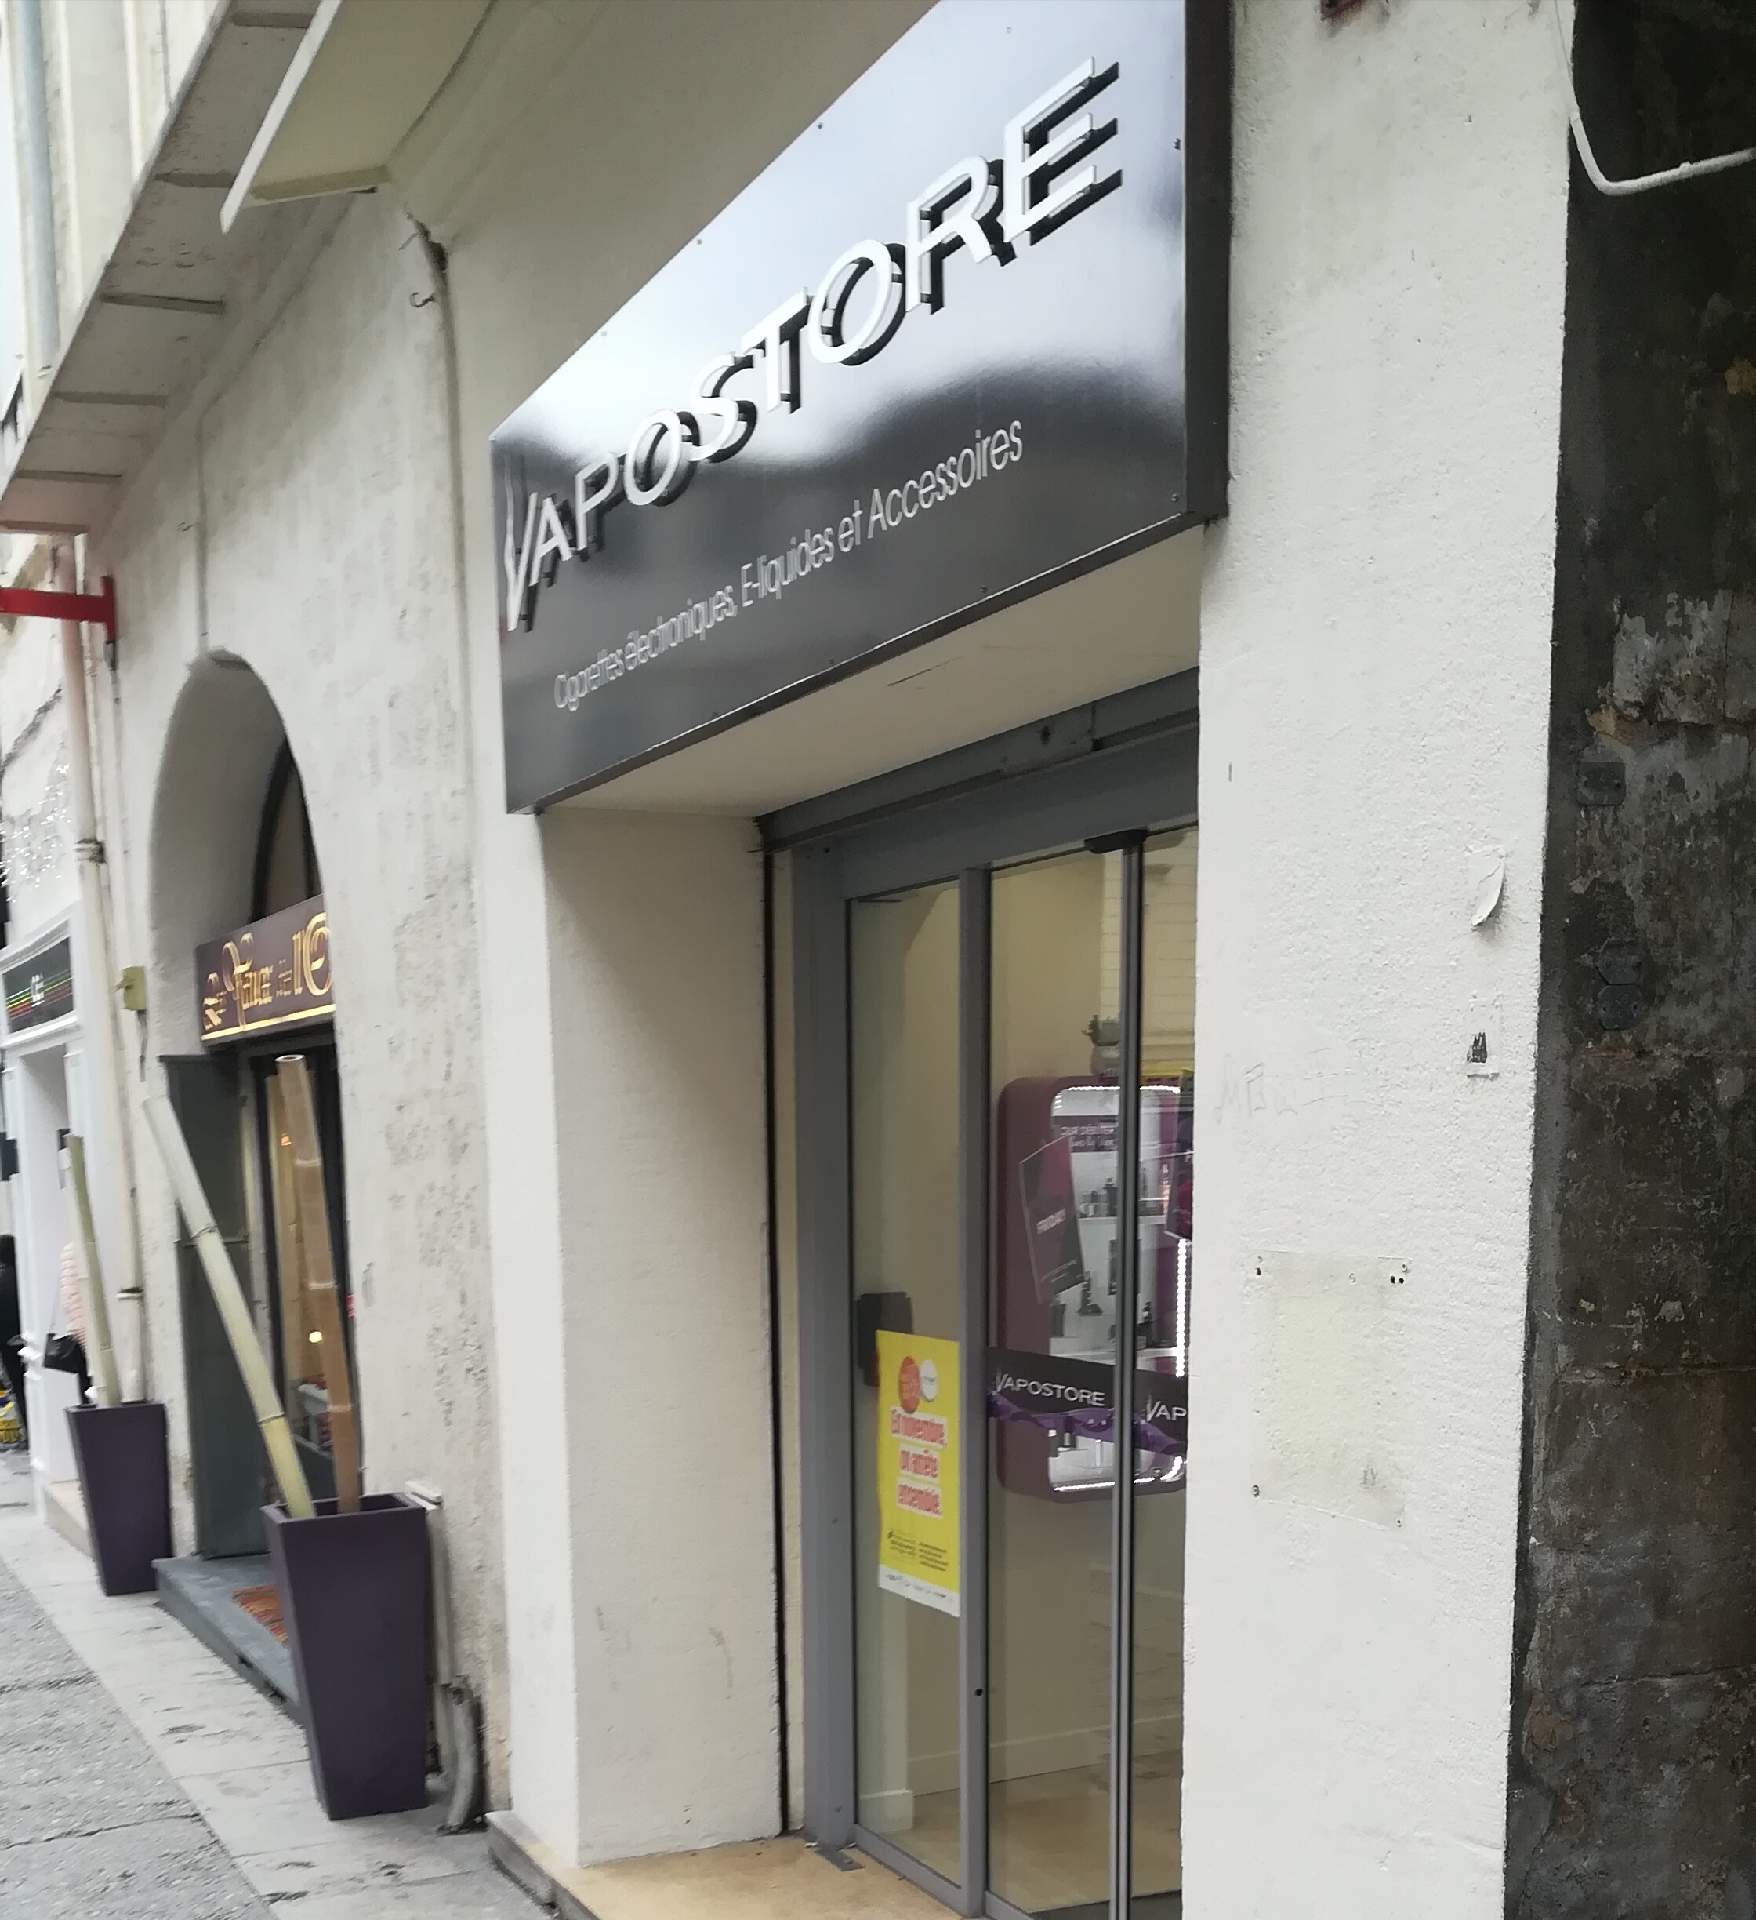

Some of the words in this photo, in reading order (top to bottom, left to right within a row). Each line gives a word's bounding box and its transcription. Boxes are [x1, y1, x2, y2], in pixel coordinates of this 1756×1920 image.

[505, 56, 1120, 632] VAPOSTORE
[741, 528, 835, 607] E-liquides
[838, 499, 863, 552] et
[867, 419, 1023, 539] Accessoires
[995, 1371, 1106, 1406] VAPOSTORE
